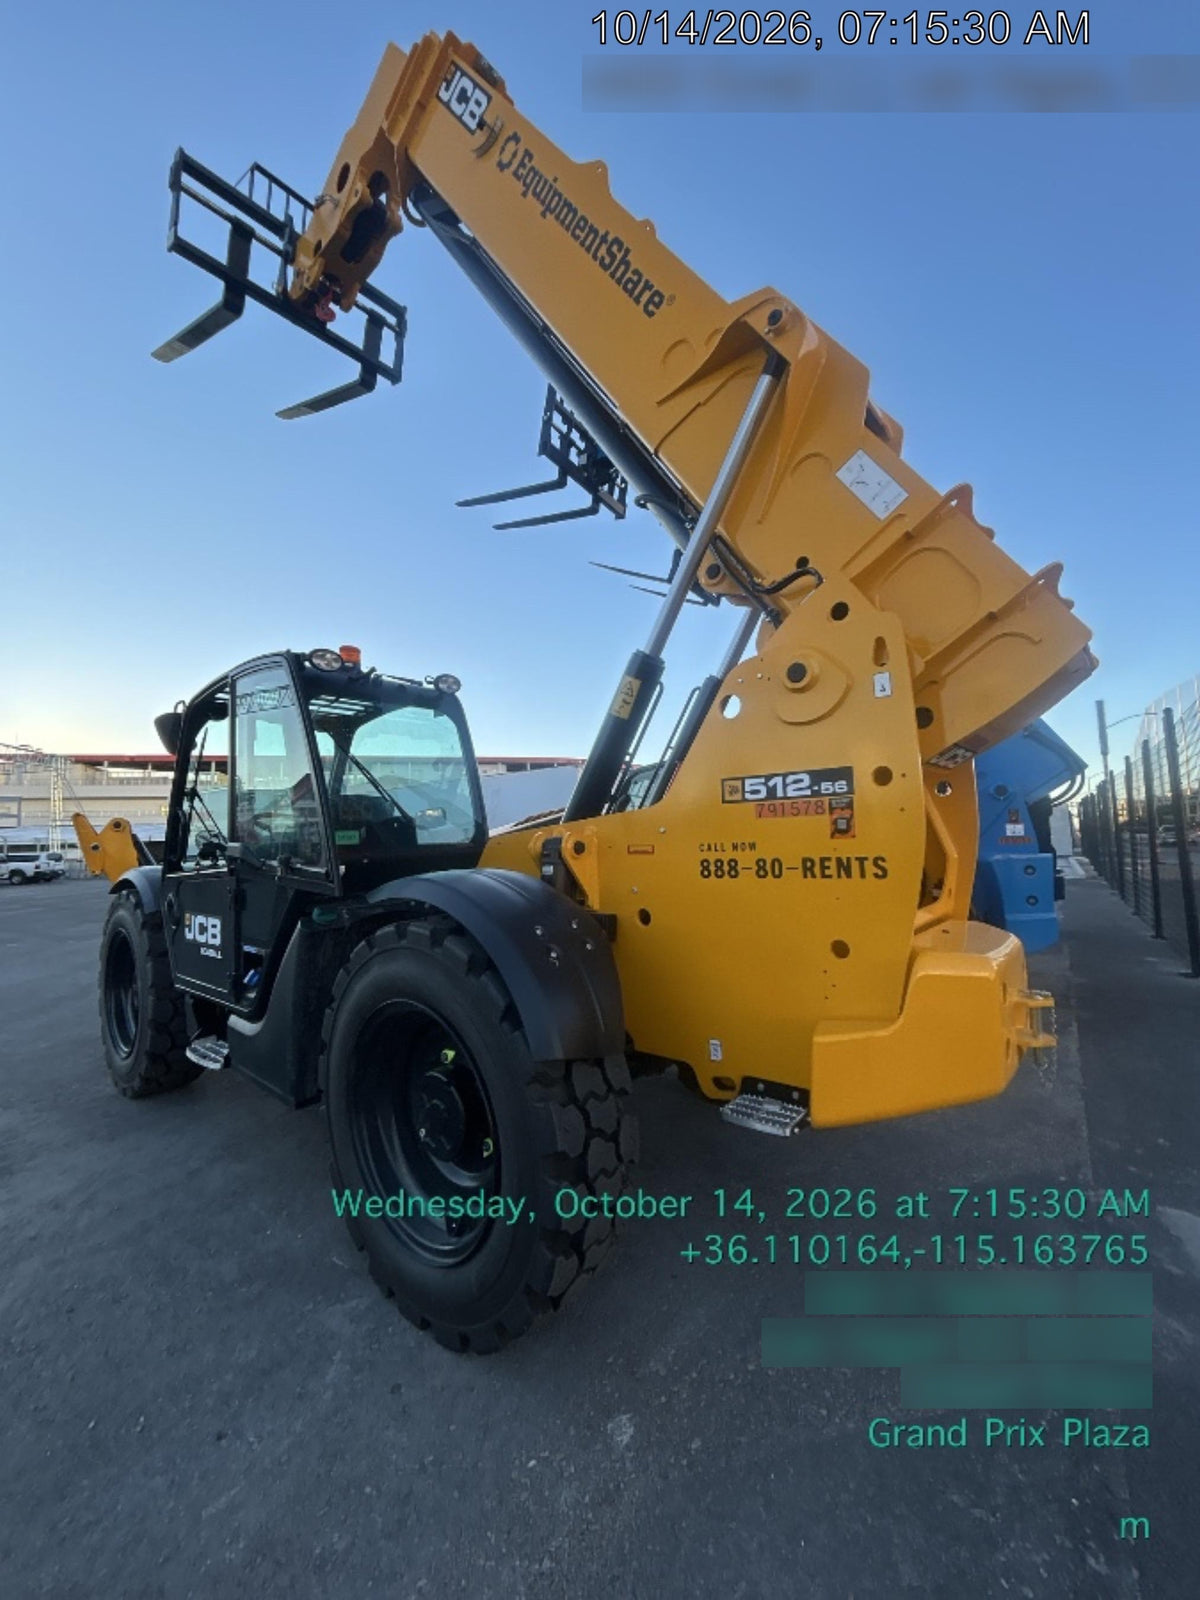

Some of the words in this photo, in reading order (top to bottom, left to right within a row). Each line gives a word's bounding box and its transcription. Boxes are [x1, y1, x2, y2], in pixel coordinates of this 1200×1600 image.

[438, 69, 489, 131] JCB
[511, 148, 666, 319] EquipmentShare
[744, 772, 849, 801] 512-56
[755, 800, 826, 819] 791578
[698, 843, 727, 853] CALL
[700, 855, 889, 880] 888-80-RENTS
[184, 914, 222, 946] JCB
